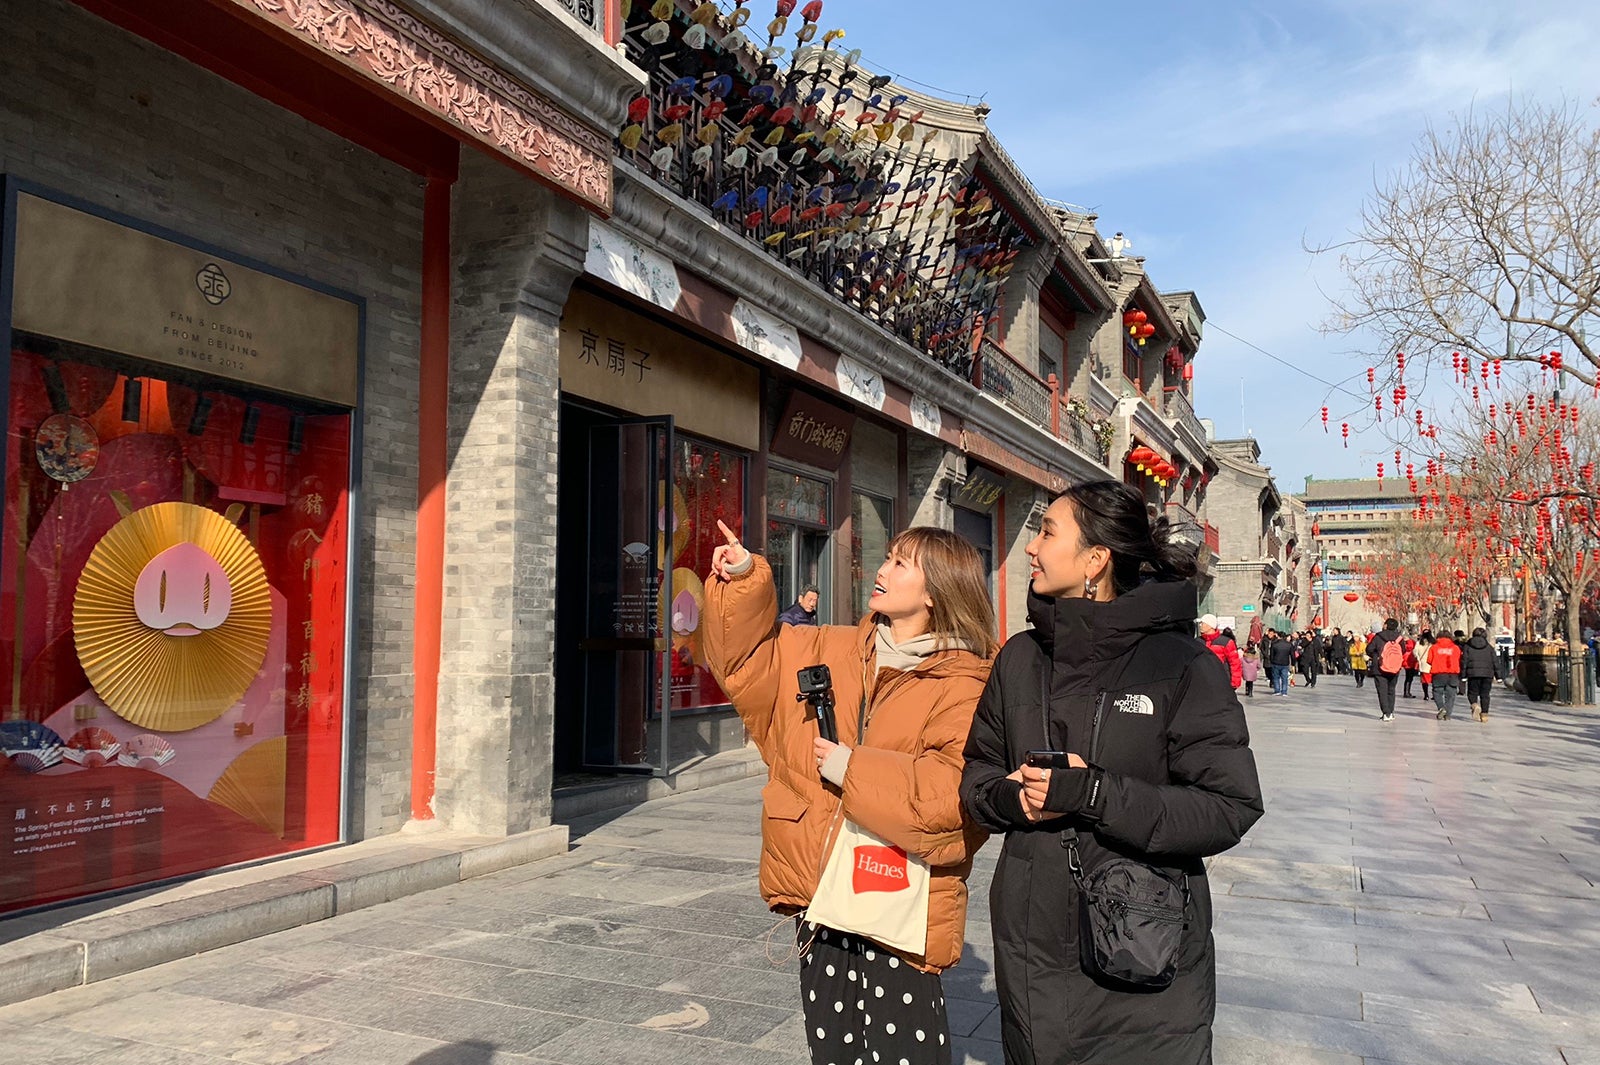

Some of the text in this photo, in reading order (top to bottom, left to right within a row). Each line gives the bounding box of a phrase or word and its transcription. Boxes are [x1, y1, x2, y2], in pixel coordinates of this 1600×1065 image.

[170, 311, 192, 324] FAN
[212, 322, 253, 340] DESIGN
[163, 326, 258, 358] FROM BEIJING
[177, 347, 245, 370] SINCE 2012
[578, 328, 652, 384] 京扇子
[1113, 699, 1139, 708] NORTH
[1120, 706, 1140, 714] FACE
[28, 824, 49, 832] Spring
[50, 820, 73, 828] Festival
[73, 816, 100, 825] greetings
[41, 831, 52, 839] you
[857, 853, 905, 879] Hanes
